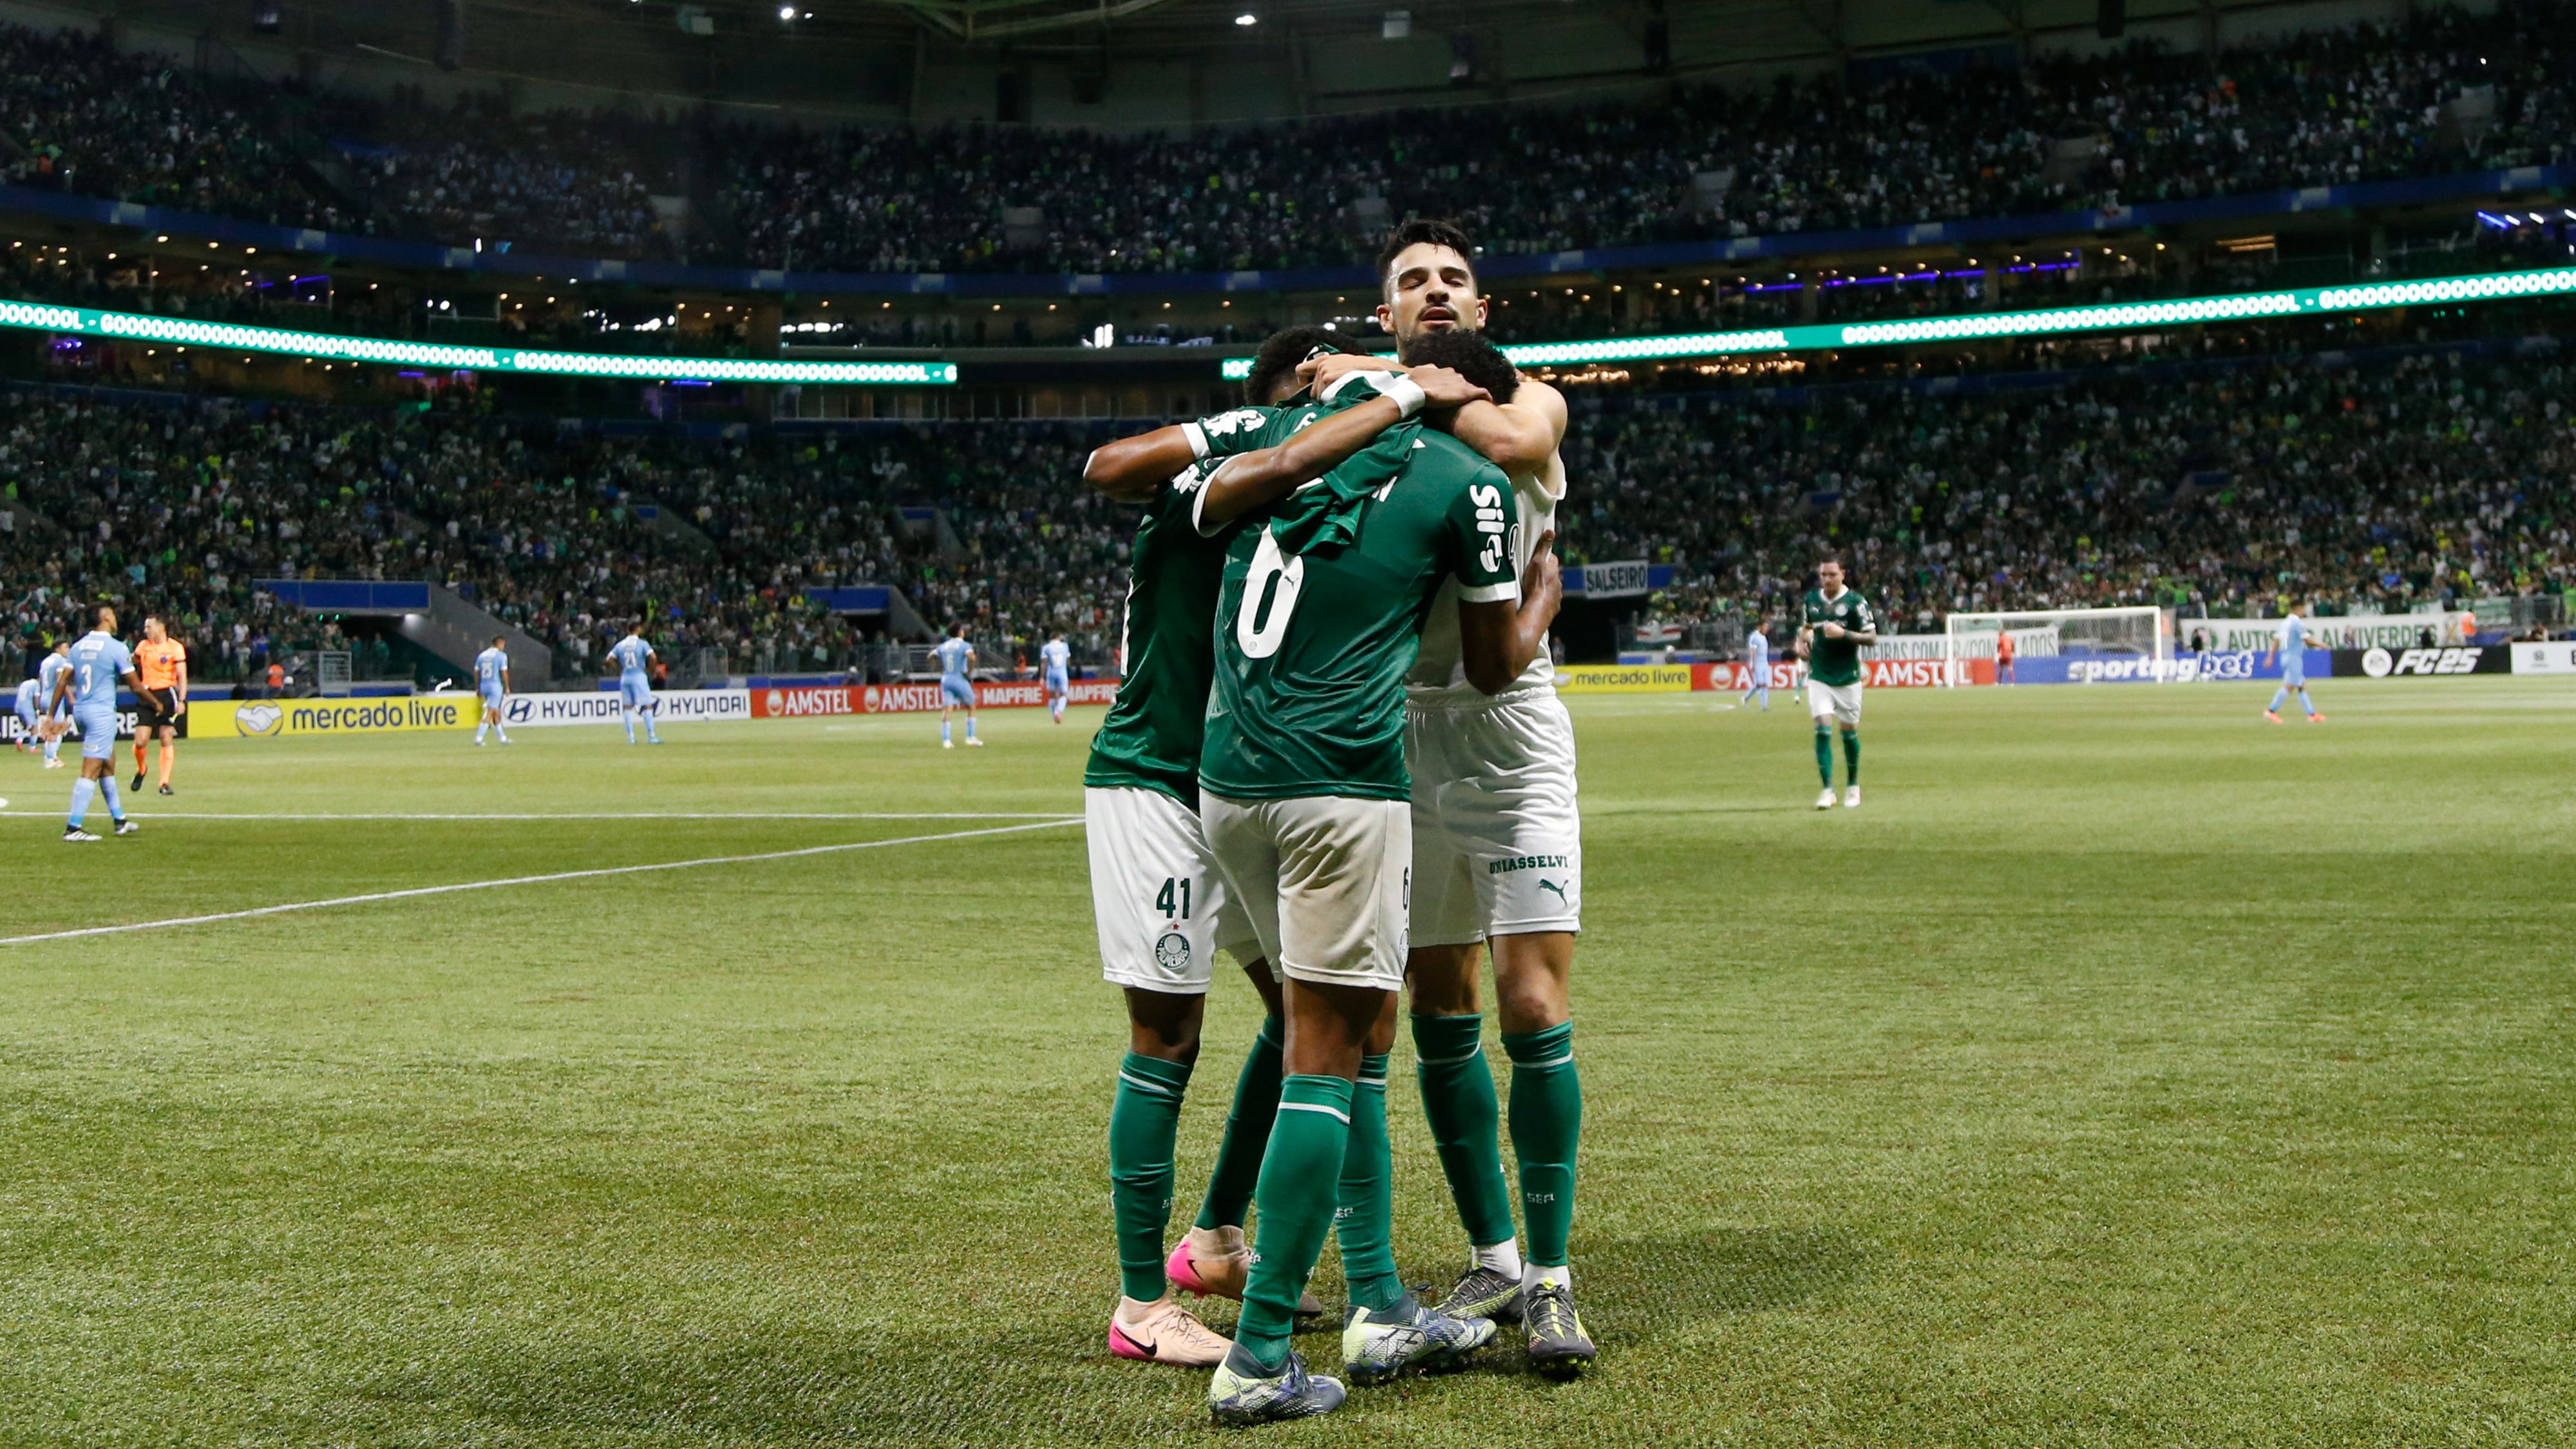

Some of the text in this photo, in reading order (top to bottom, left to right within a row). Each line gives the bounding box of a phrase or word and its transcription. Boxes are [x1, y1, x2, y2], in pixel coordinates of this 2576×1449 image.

[1586, 565, 1647, 592] SALSEIRO
[81, 663, 92, 696] 3
[1576, 670, 1687, 685] mercado livre
[670, 696, 746, 715] HYUNDAI
[786, 689, 852, 715] AMSTEL
[881, 687, 943, 711] AMSTEL
[983, 687, 1043, 705] MAPFRE
[292, 700, 457, 729] mercado livre
[1489, 855, 1569, 874] UNIASSELVI
[1156, 877, 1191, 920] 41
[1157, 947, 1189, 967] PALMEIRAS
